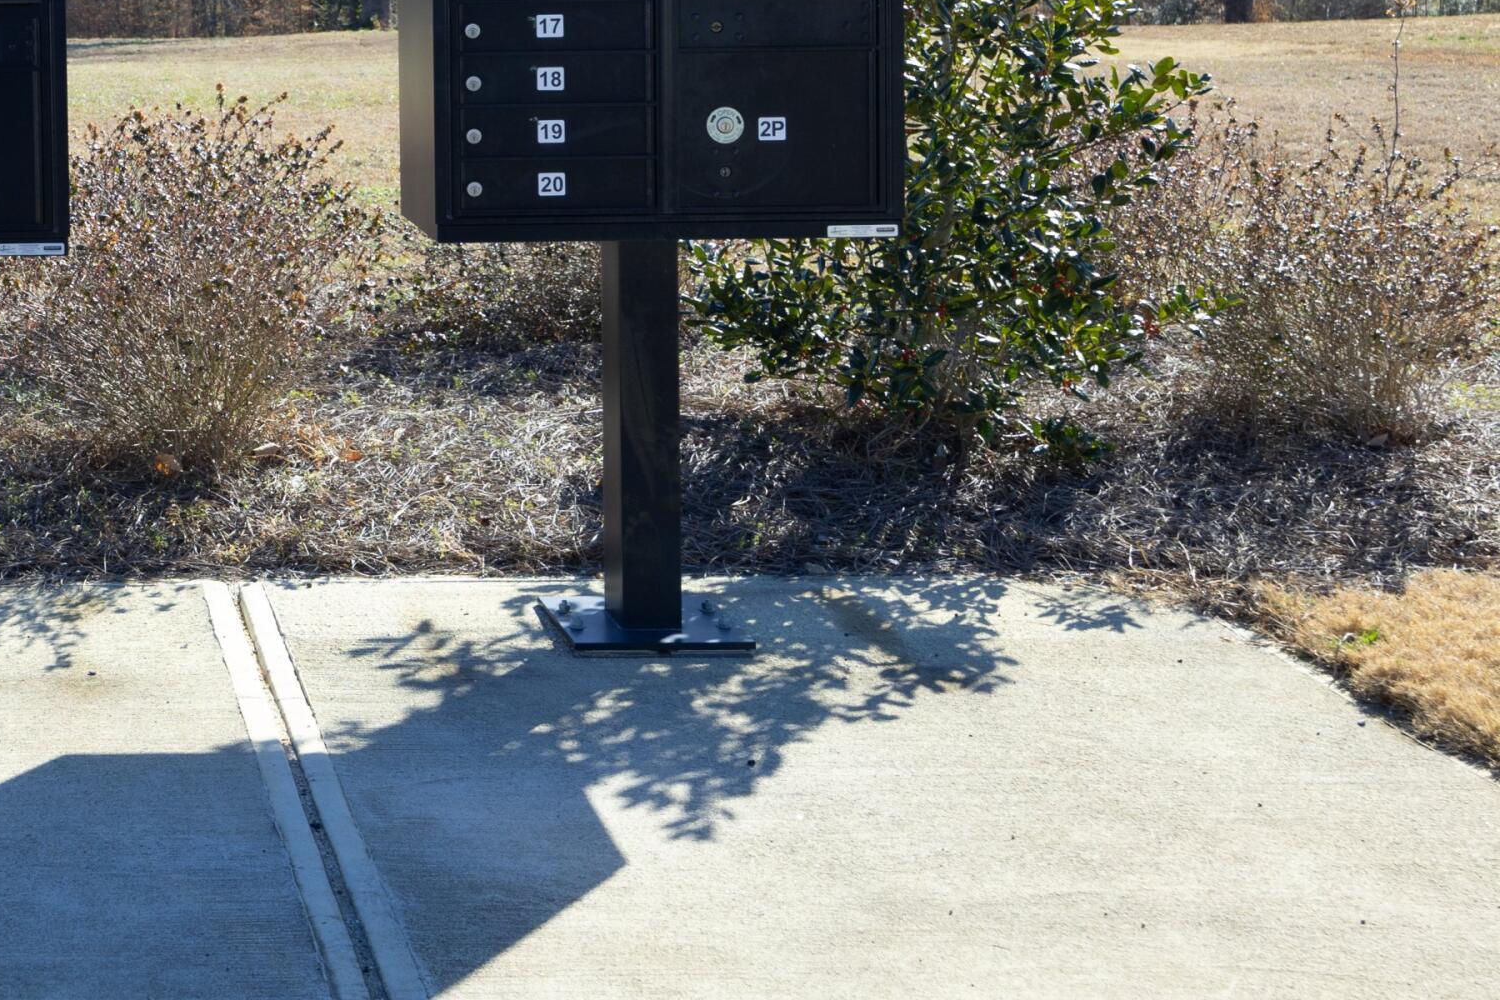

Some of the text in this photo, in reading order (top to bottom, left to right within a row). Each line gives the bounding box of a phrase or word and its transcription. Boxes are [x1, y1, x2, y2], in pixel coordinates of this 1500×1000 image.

[539, 17, 561, 34] 17
[539, 70, 562, 88] 18
[540, 123, 563, 140] 19
[759, 120, 785, 137] 2P
[540, 176, 564, 193] 20
